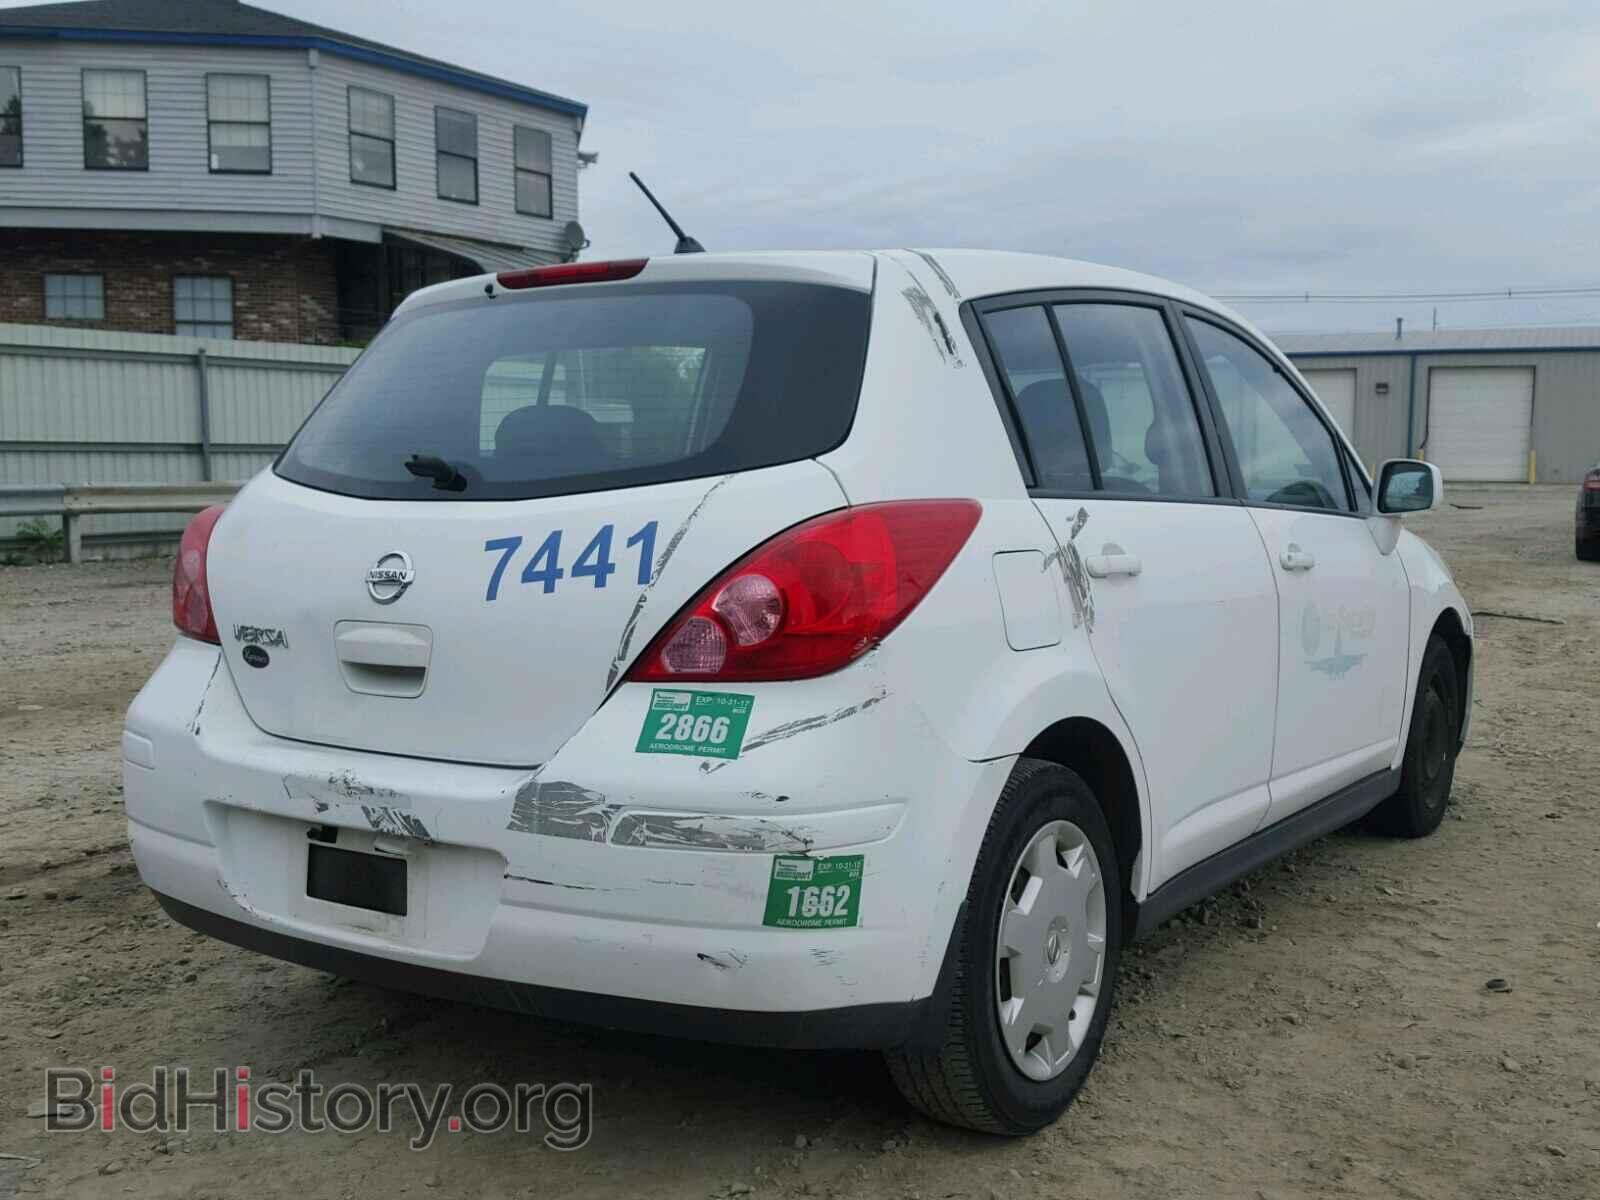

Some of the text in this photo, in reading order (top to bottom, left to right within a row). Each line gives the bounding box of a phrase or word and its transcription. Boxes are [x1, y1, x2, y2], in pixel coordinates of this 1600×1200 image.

[485, 520, 658, 601] 7441
[369, 570, 408, 580] NISSAN
[233, 624, 289, 649] VERSA
[654, 712, 731, 744] 2866
[698, 746, 727, 754] PERMIT
